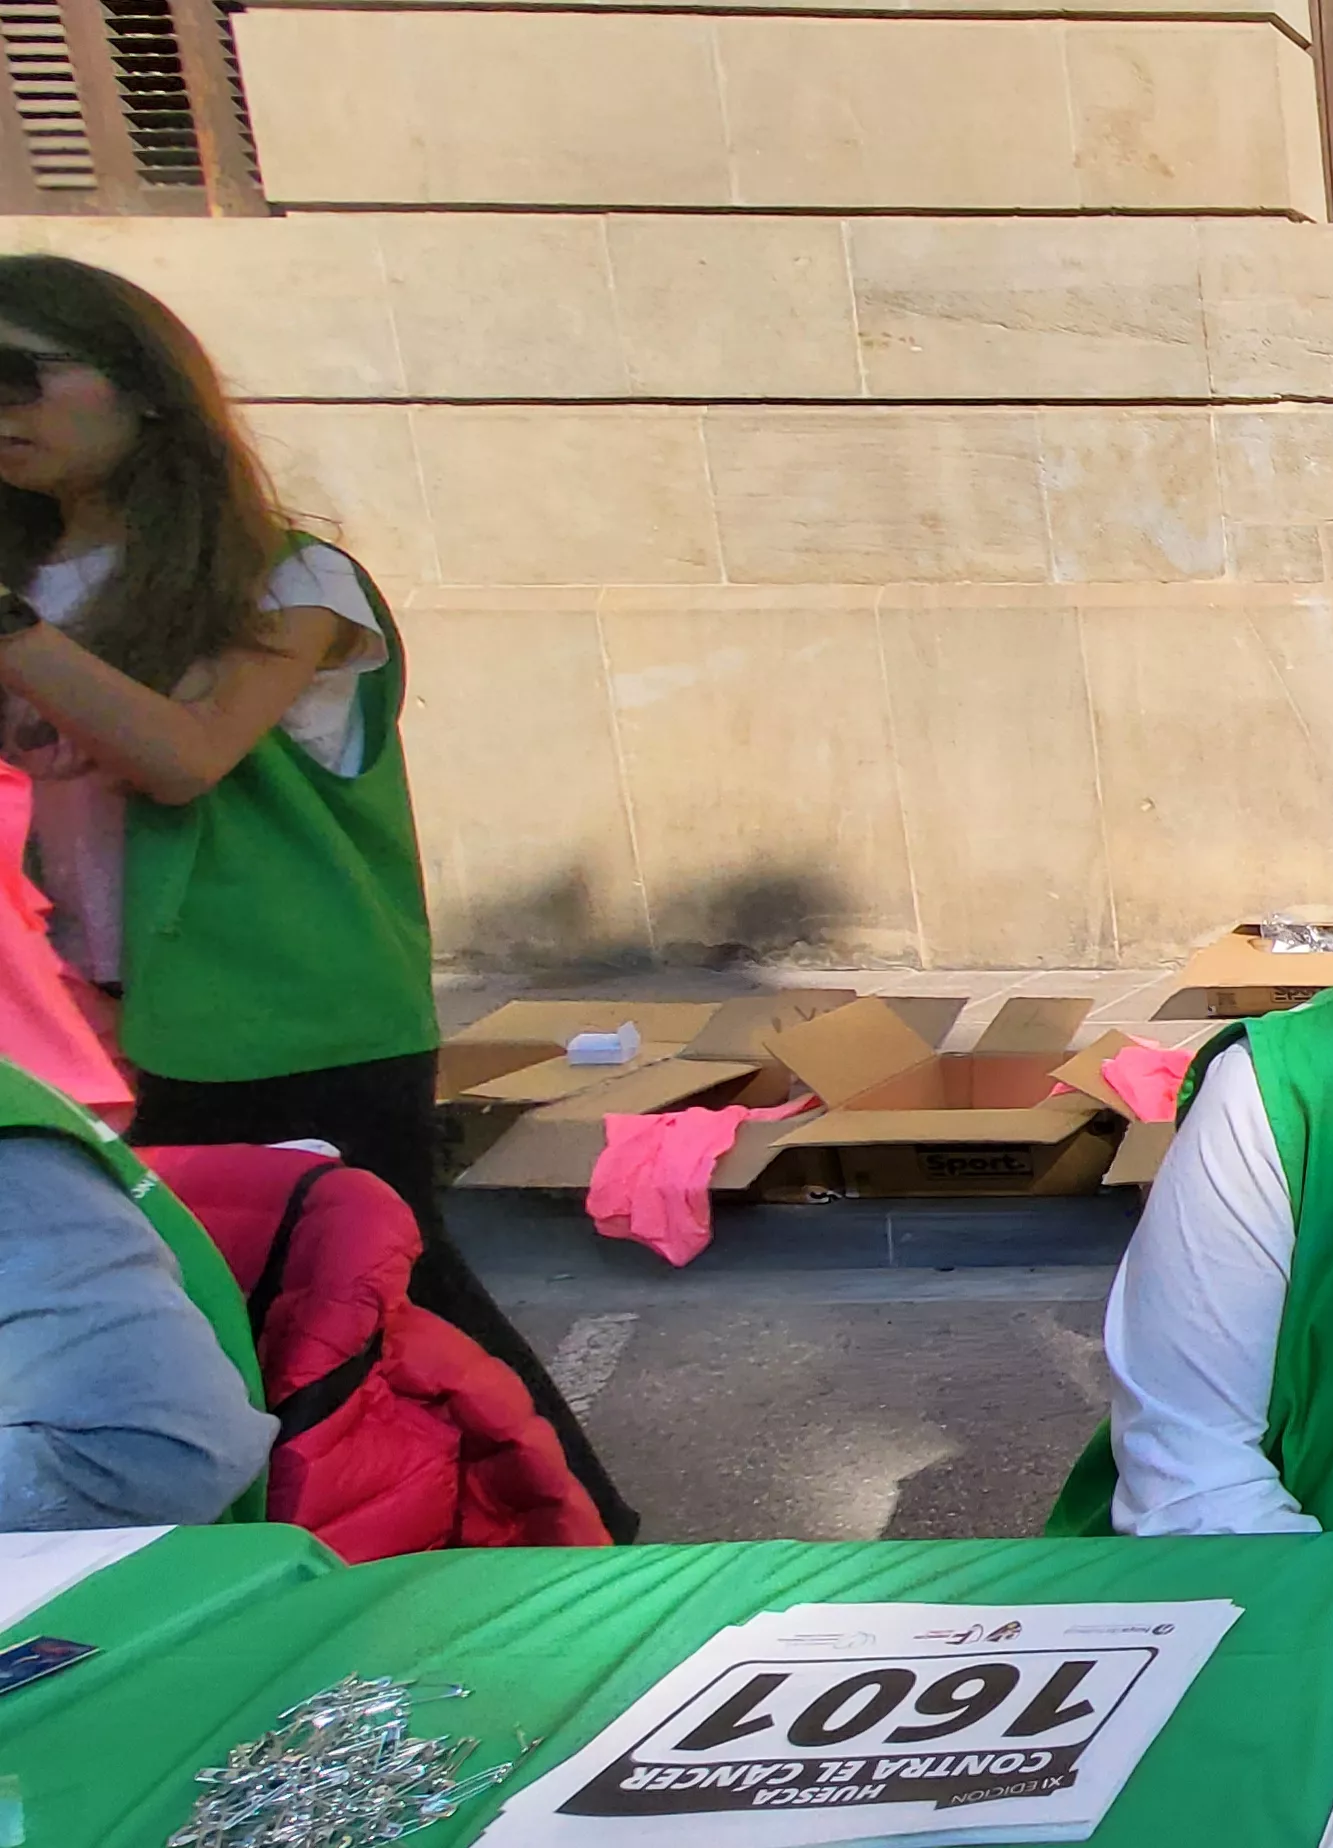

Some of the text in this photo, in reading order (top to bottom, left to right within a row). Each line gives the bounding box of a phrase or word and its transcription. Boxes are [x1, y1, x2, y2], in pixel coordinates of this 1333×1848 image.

[671, 1659, 1098, 1752] 1601
[619, 1750, 1054, 1793] CONTRA EL CÁNCER
[1039, 1774, 1065, 1790] XI
[752, 1783, 888, 1806] HUESCA
